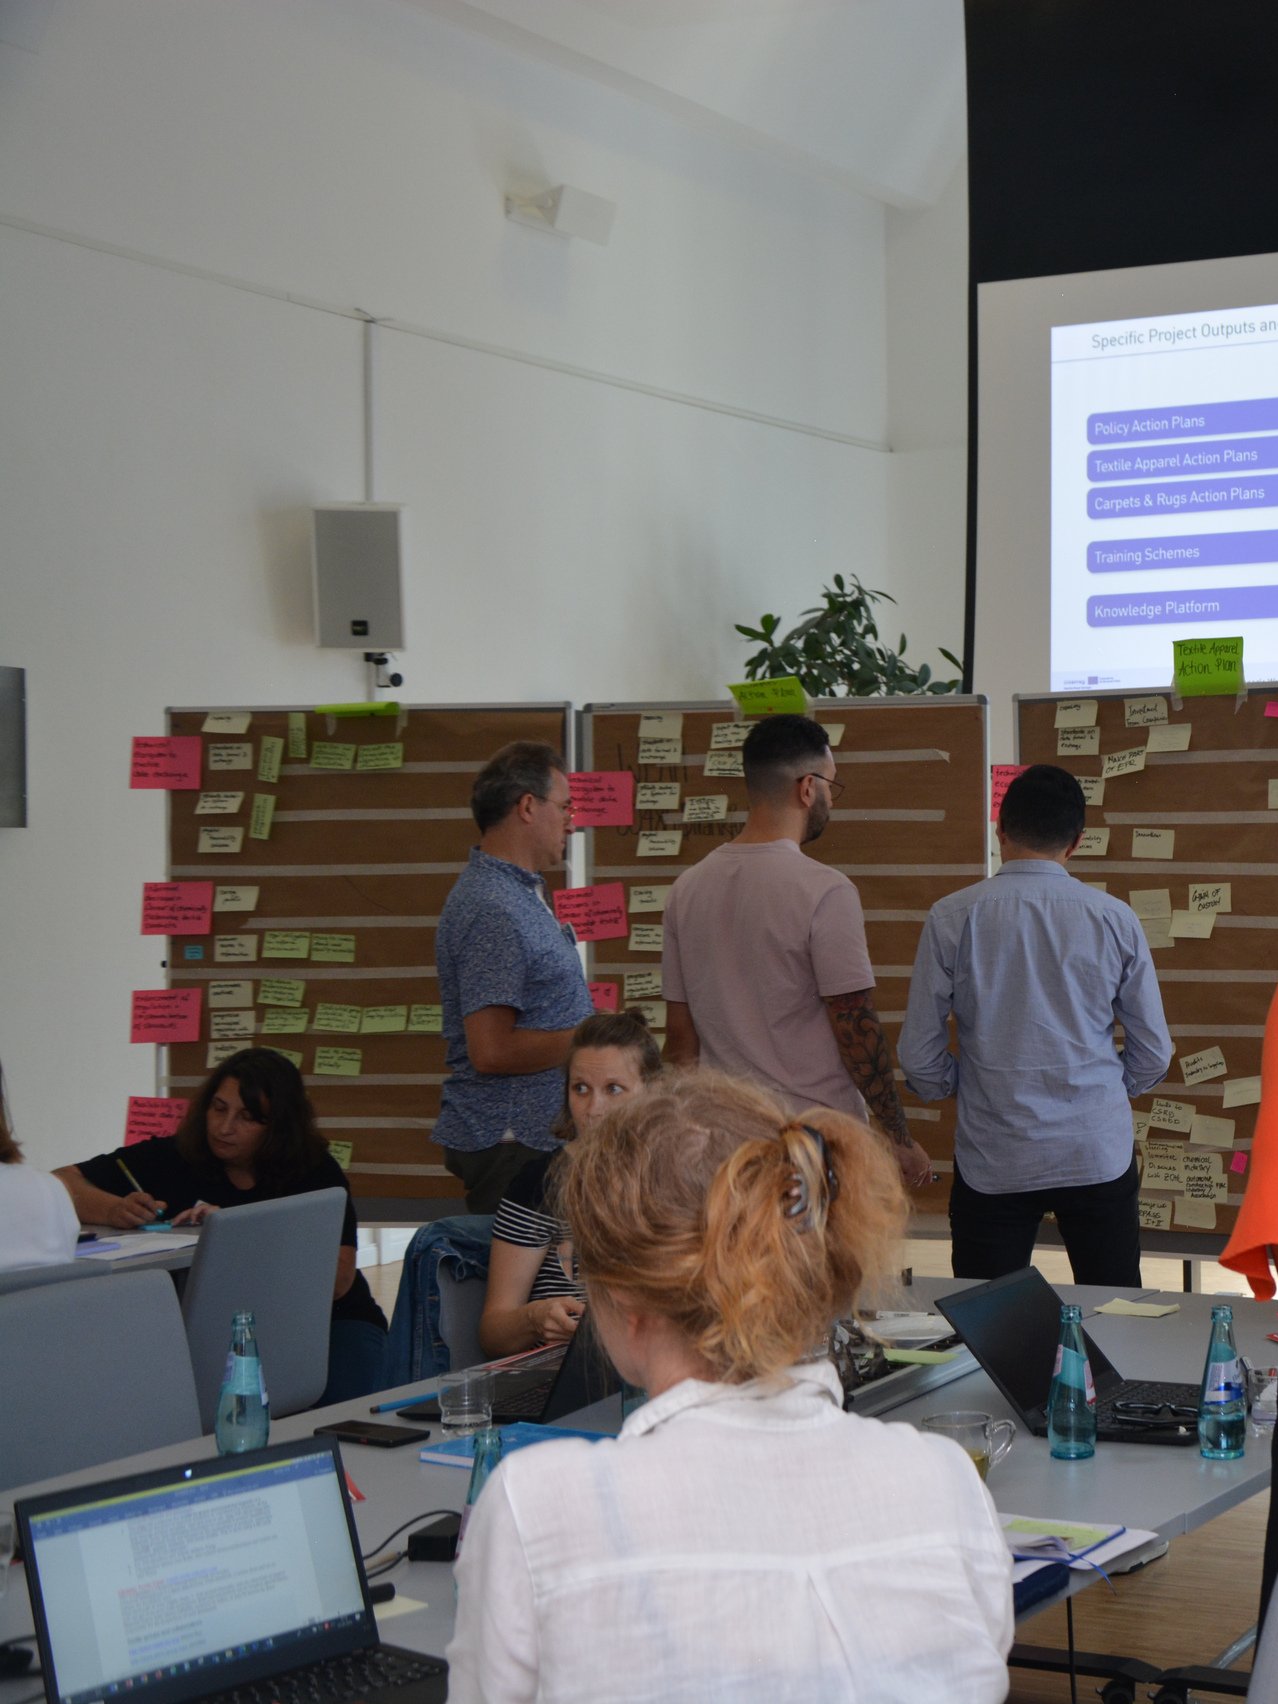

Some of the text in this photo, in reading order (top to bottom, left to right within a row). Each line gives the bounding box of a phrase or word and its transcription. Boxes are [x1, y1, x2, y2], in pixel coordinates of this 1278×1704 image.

[1091, 330, 1144, 351] Specific
[1148, 326, 1197, 345] Project
[1200, 321, 1256, 339] Outputs
[1094, 415, 1205, 437] Policy Action Plans
[1094, 449, 1258, 473] Textile Apparel Action Plans
[1094, 486, 1265, 512] Carpets & Rugs Action Plans
[1094, 546, 1200, 565] Training Schemes
[1094, 599, 1220, 619] Knowledge Platform
[1178, 642, 1208, 656] Textile
[1179, 658, 1238, 677] Action Plan
